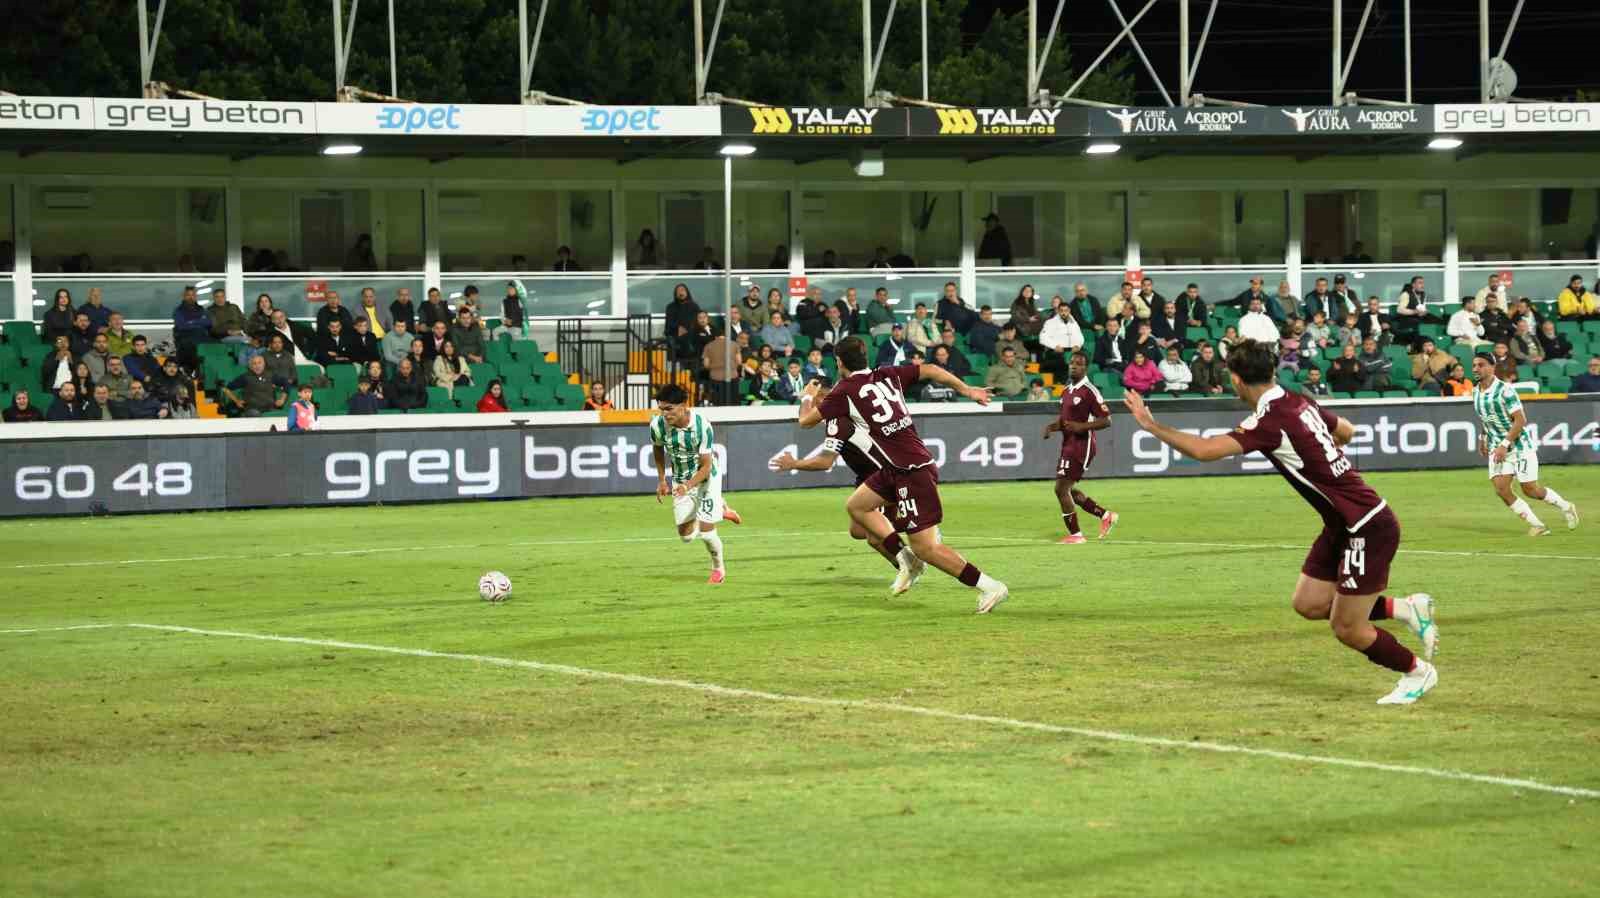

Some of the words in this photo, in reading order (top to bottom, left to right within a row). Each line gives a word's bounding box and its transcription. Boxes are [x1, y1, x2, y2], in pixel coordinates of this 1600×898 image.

[0, 99, 80, 120] eton
[106, 105, 191, 128] grey
[202, 101, 303, 124] beton
[376, 104, 460, 133] opet
[581, 107, 661, 134] opet
[791, 108, 879, 125] TALAY
[976, 108, 1061, 125] TALAY
[1184, 110, 1247, 124] ACROPOL
[1358, 109, 1418, 122] ACROPOL
[1443, 108, 1505, 129] grey
[1515, 105, 1591, 123] beton
[798, 126, 872, 134] LOGISTICS
[983, 126, 1056, 134] LOGISTICS
[1135, 118, 1178, 132] AURA
[1309, 117, 1350, 131] AURA
[858, 375, 910, 424] 34
[1341, 415, 1476, 455] eton
[960, 435, 1024, 467] 48
[15, 464, 95, 500] 60
[112, 461, 193, 497] 48
[324, 447, 500, 499] grey
[898, 498, 919, 518] 34
[1343, 549, 1365, 576] 14
